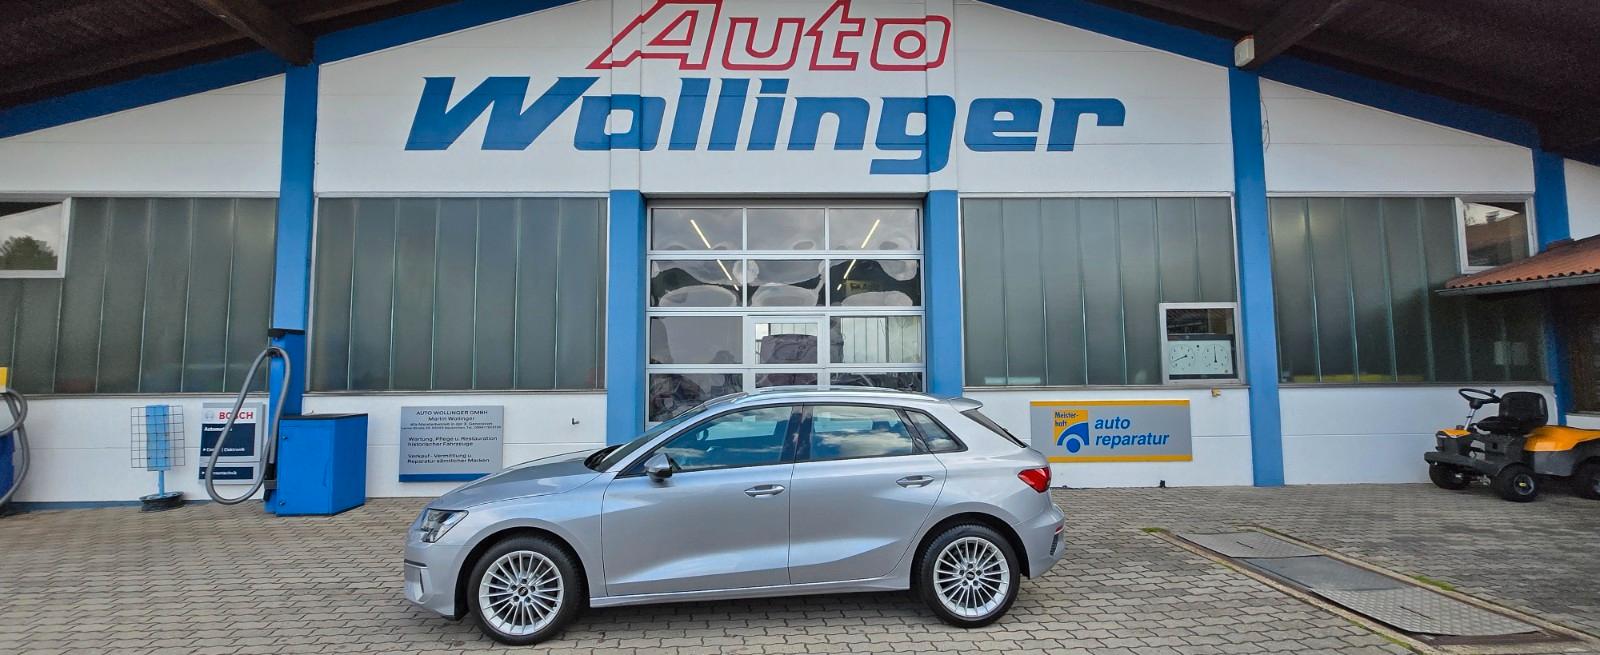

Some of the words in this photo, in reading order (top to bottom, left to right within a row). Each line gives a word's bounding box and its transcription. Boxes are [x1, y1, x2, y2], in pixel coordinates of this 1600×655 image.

[587, 0, 952, 71] Auto
[404, 76, 1126, 175] Wollinger
[1094, 416, 1131, 430] auto
[1095, 434, 1170, 449] reparatur
